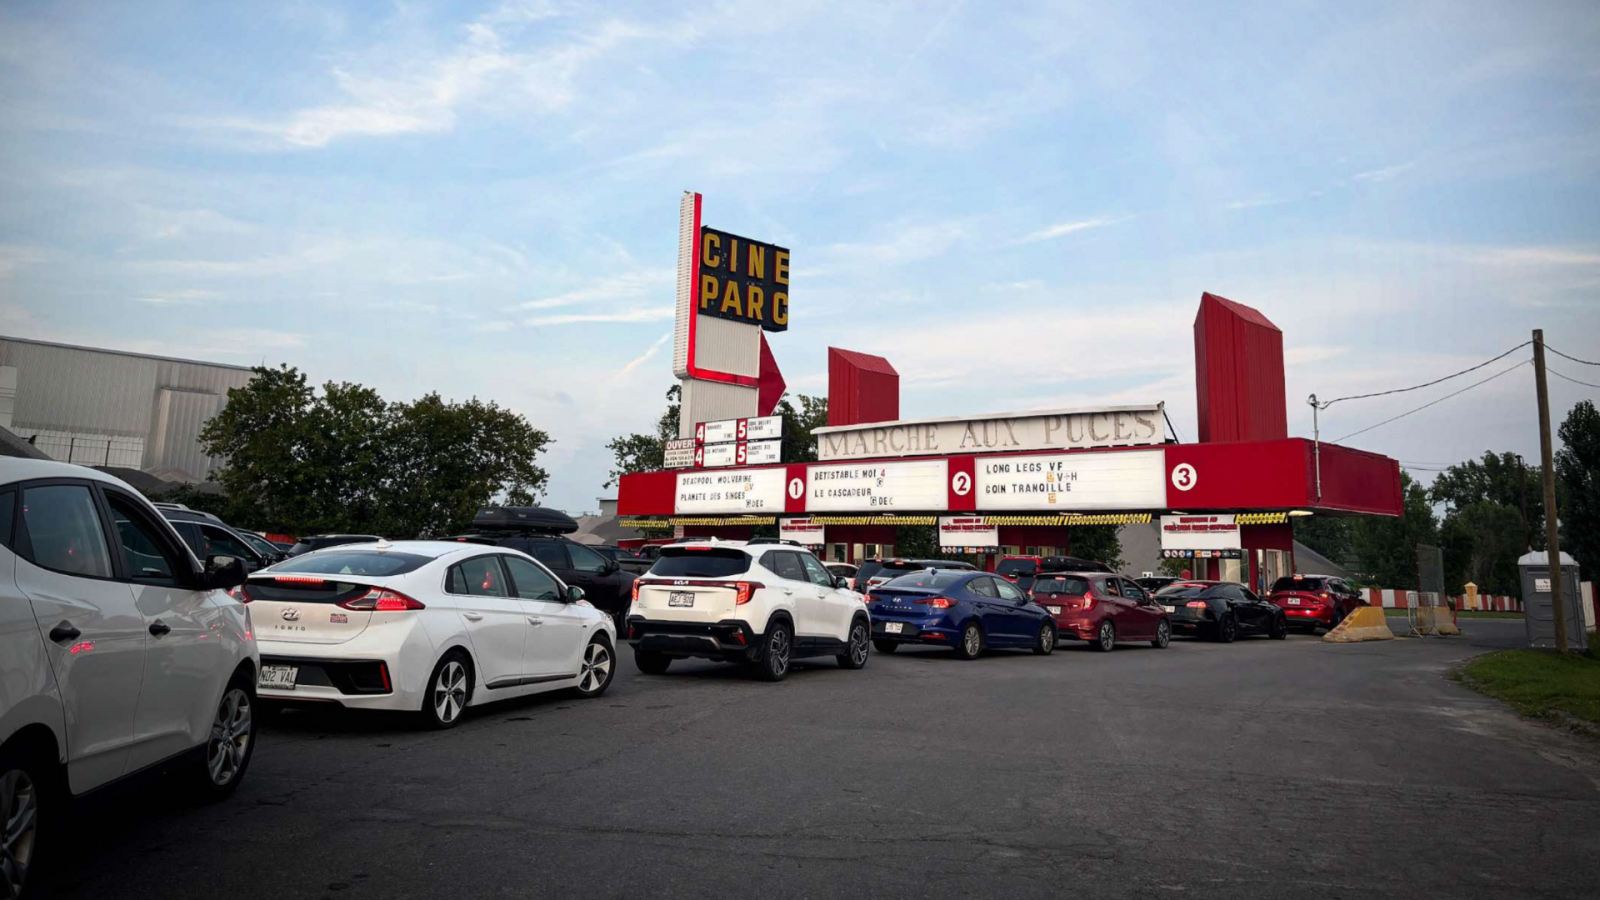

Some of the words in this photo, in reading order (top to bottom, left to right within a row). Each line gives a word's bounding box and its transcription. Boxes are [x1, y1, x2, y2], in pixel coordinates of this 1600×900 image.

[703, 232, 789, 285] CINE
[702, 274, 788, 325] PARC
[697, 425, 704, 441] 4
[738, 421, 746, 438] 5
[824, 423, 939, 457] MARCHE
[960, 418, 1020, 449] AUX
[1043, 410, 1156, 444] PUCES
[695, 448, 703, 465] 4
[737, 446, 746, 462] 5
[814, 469, 859, 481] DETESTABLE
[862, 469, 876, 478] MOI
[880, 469, 886, 477] 4
[986, 464, 1010, 474] LONG
[1016, 462, 1042, 473] LEGS
[1049, 462, 1063, 471] VF
[957, 475, 967, 492] 2
[1178, 467, 1191, 486] 3
[793, 481, 799, 496] 1
[814, 489, 824, 498] LE
[827, 488, 872, 497] CASCADEUR
[280, 671, 295, 683] VAL
